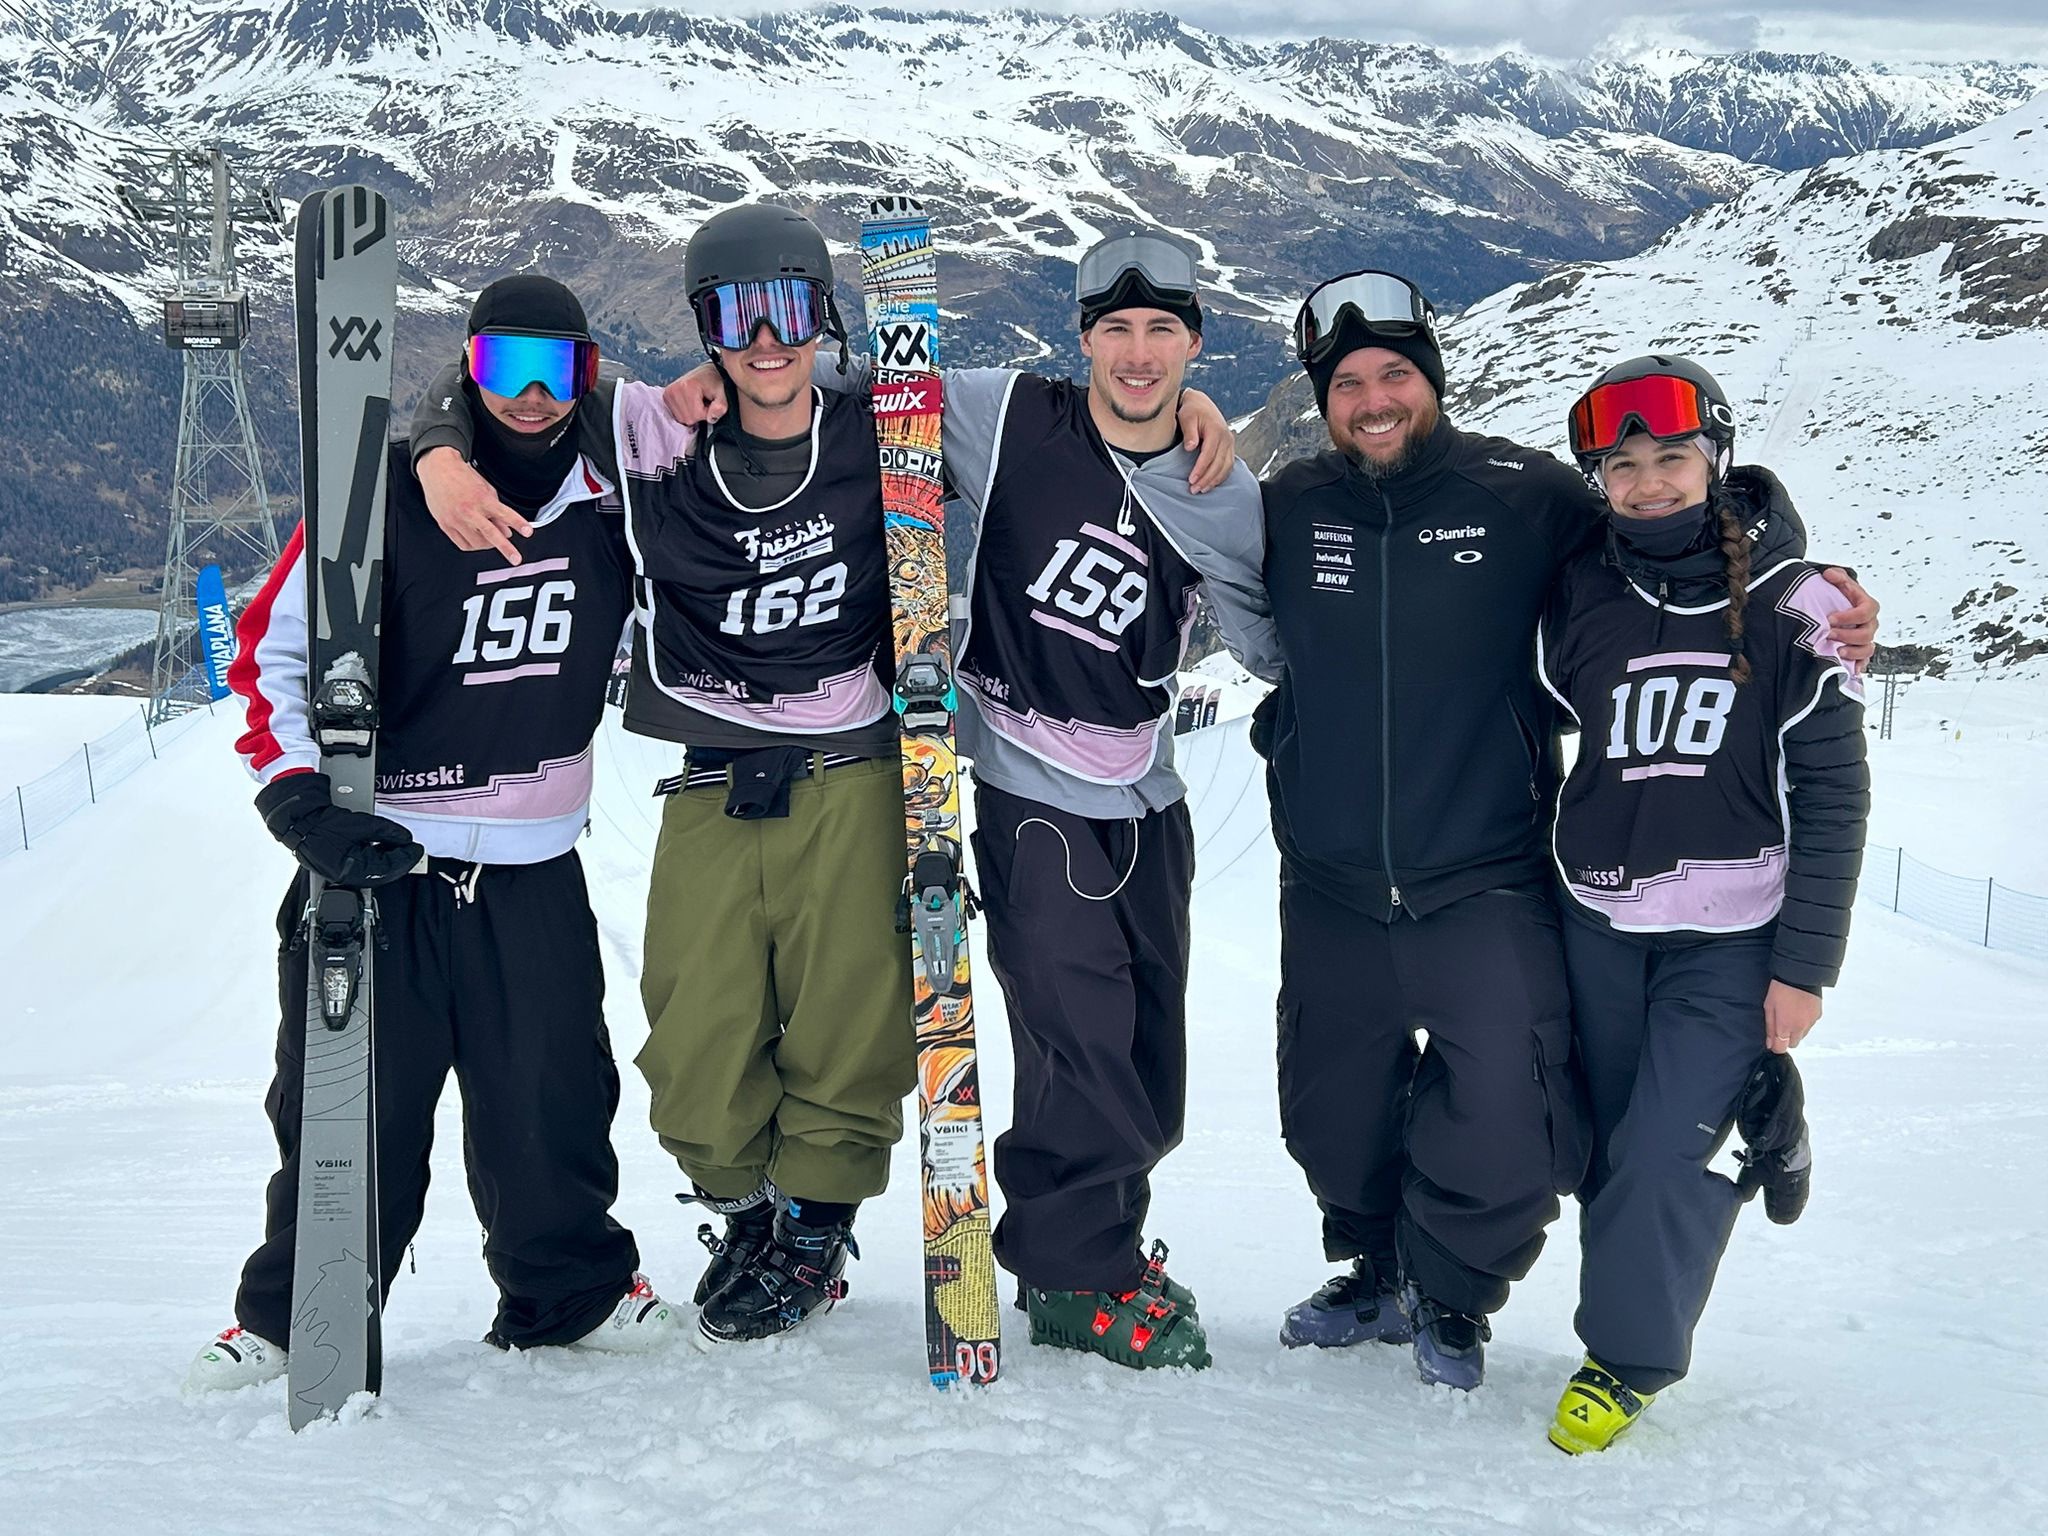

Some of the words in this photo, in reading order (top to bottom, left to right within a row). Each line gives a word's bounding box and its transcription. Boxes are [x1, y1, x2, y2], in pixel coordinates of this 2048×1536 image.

[183, 337, 222, 345] MONCLER
[1314, 530, 1354, 544] RAIFFEISEN
[1435, 525, 1486, 541] Sunrise
[1025, 538, 1149, 636] 159
[1324, 573, 1350, 586] BKW
[718, 560, 849, 636] 162
[451, 579, 576, 665] 156
[1605, 676, 1738, 760] 108
[934, 1124, 968, 1134] Völkl
[315, 1159, 352, 1168] Völkl
